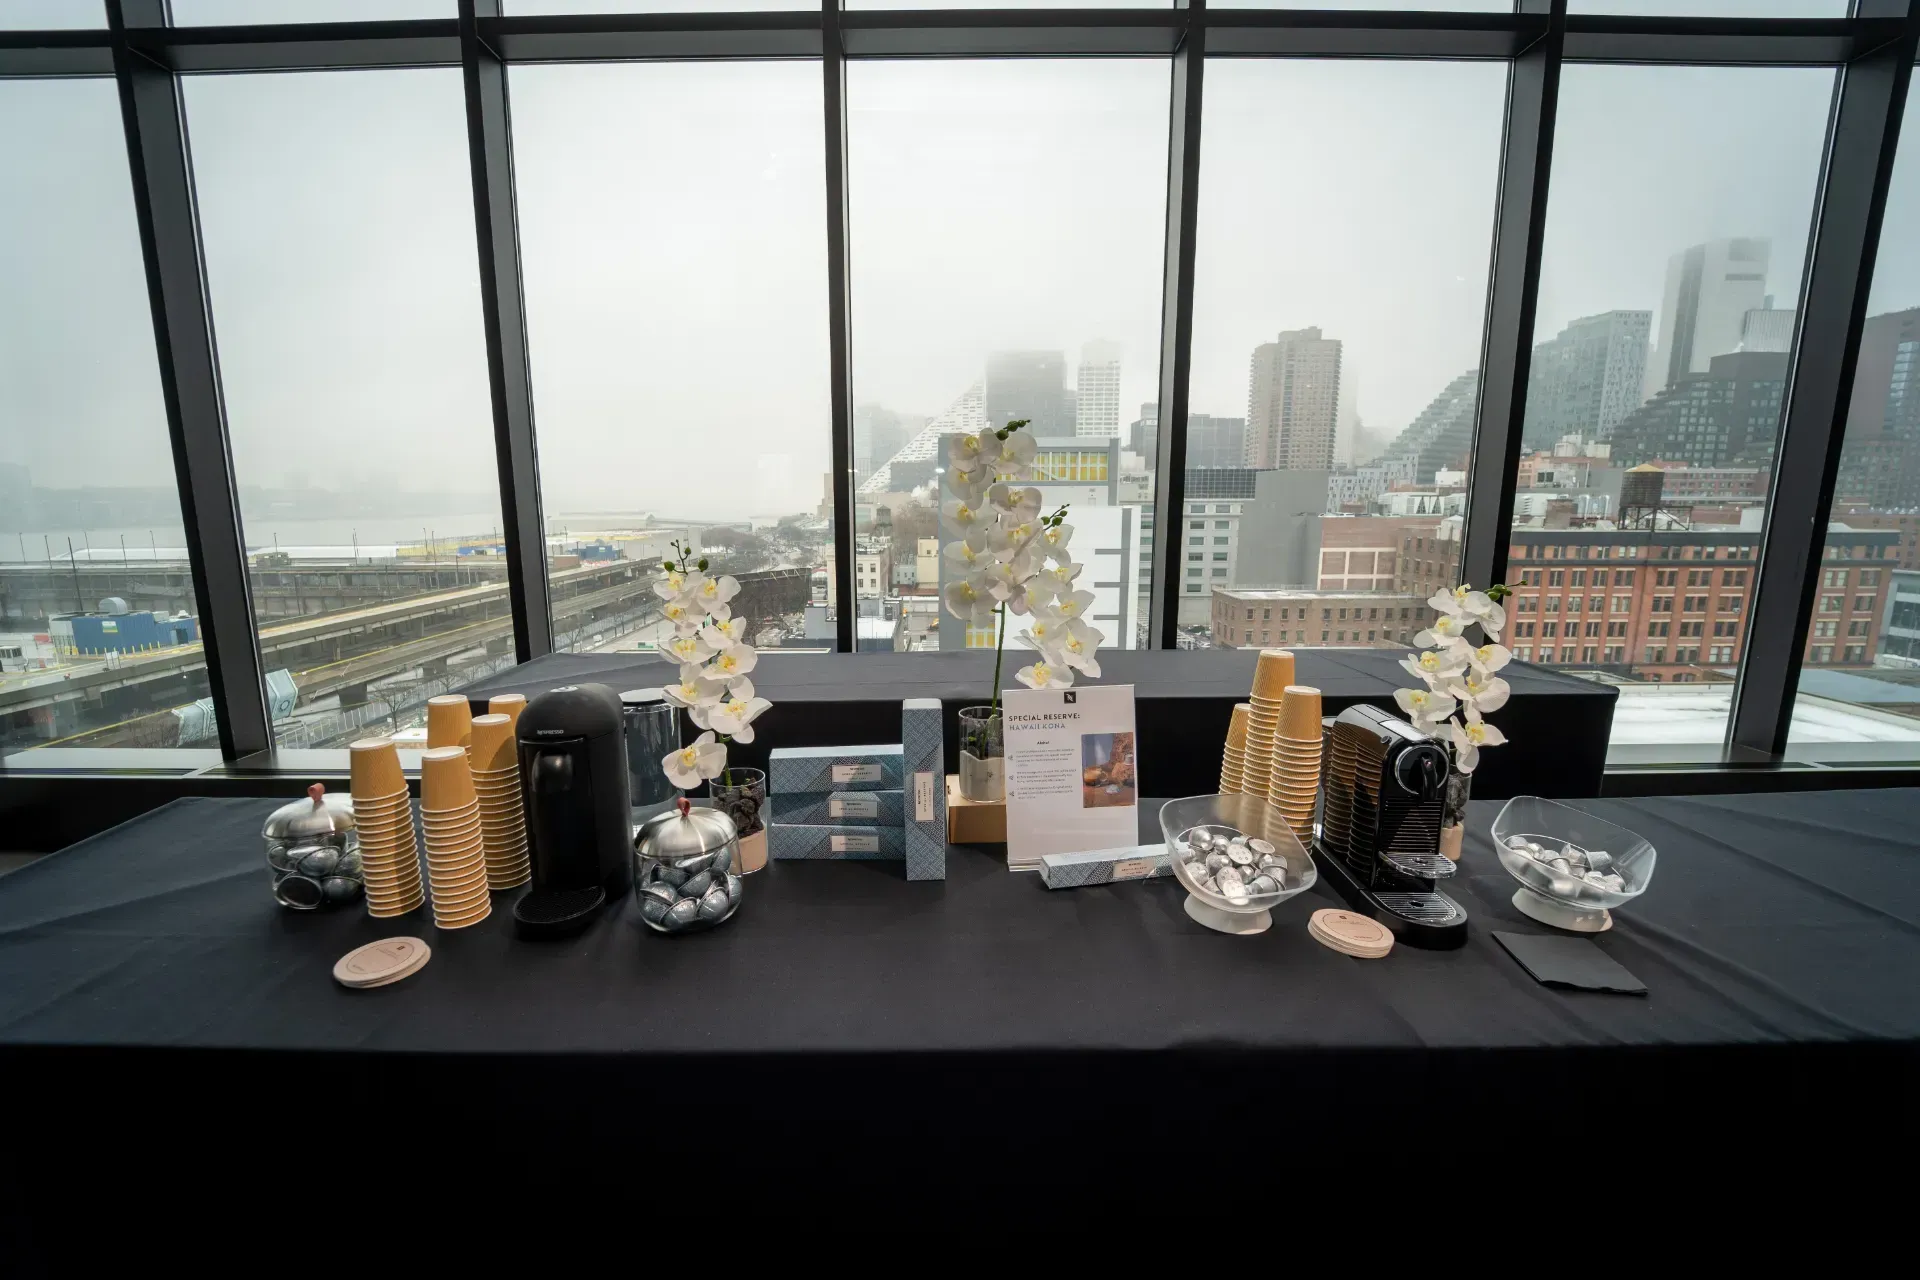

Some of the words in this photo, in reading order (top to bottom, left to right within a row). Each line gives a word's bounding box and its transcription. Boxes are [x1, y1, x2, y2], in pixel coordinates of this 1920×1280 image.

[1008, 714, 1042, 722] SPECIAL
[1043, 712, 1081, 720] RESERVE:
[1009, 723, 1040, 731] HAWAII
[1042, 722, 1066, 730] KONA
